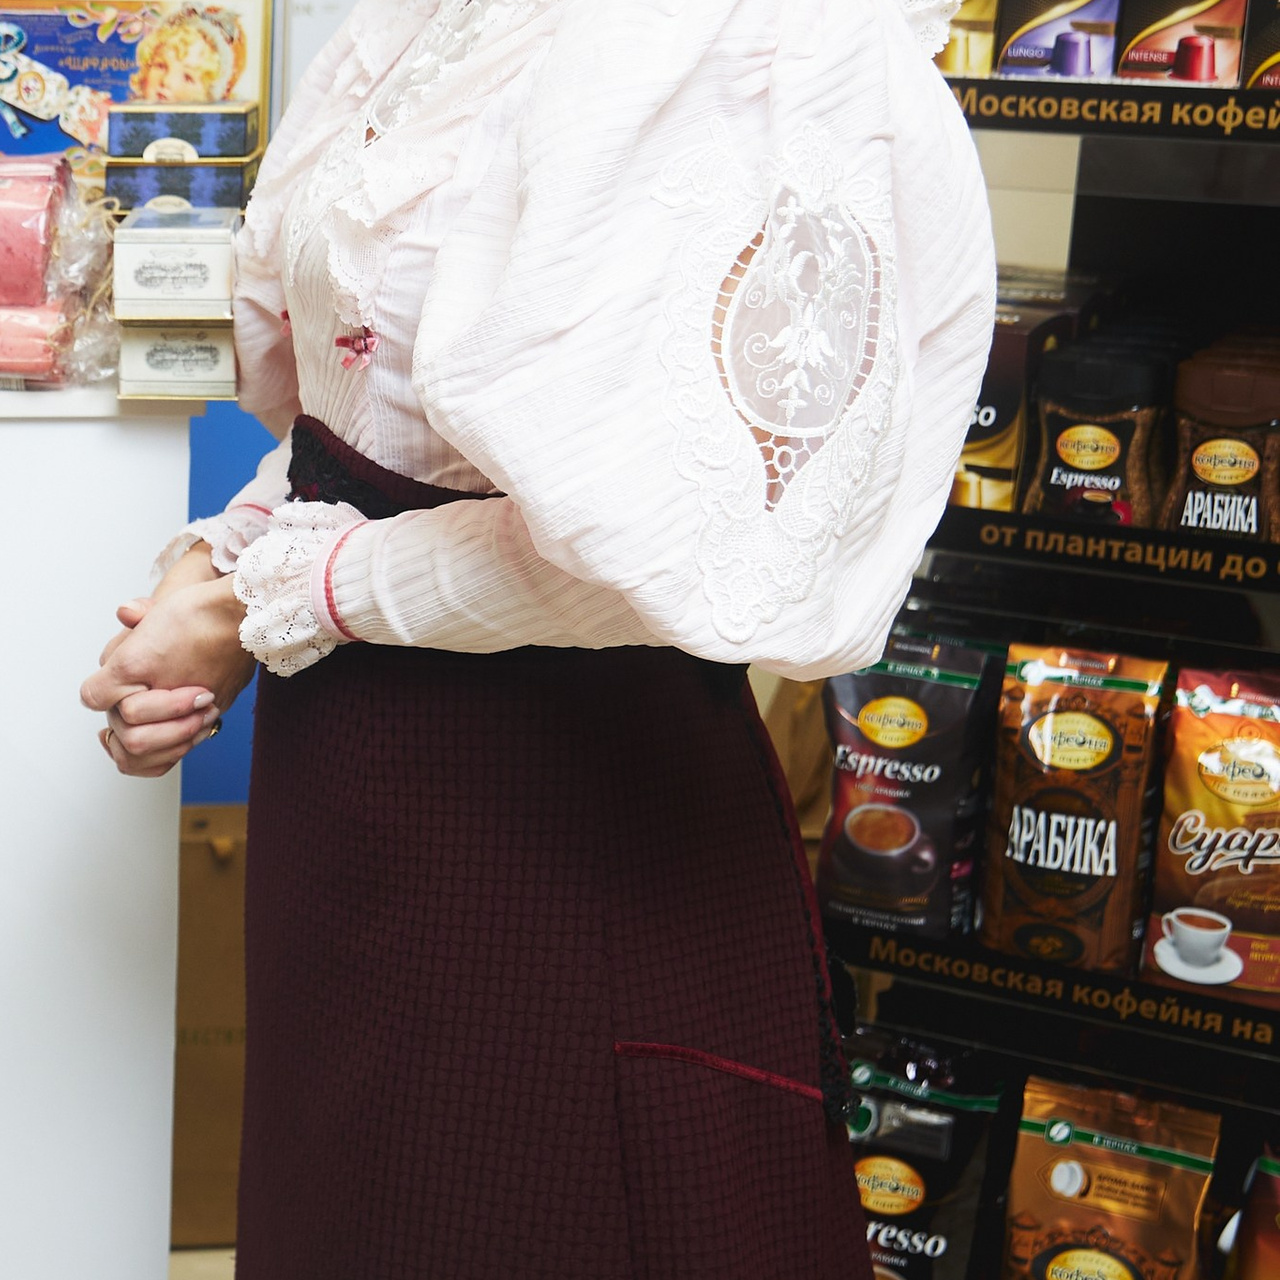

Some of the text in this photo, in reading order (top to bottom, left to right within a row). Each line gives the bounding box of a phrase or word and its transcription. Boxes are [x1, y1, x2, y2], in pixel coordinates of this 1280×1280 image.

[1007, 48, 1044, 58] LUNGO
[1127, 51, 1168, 63] INTENSE
[1050, 467, 1121, 490] Espresso
[1180, 490, 1258, 534] АРАБИКА
[980, 524, 1267, 582] от плантации до
[835, 744, 942, 784] Espresso
[1005, 805, 1117, 877] АРАБИКА
[869, 936, 1274, 1045] Московская кофейня на
